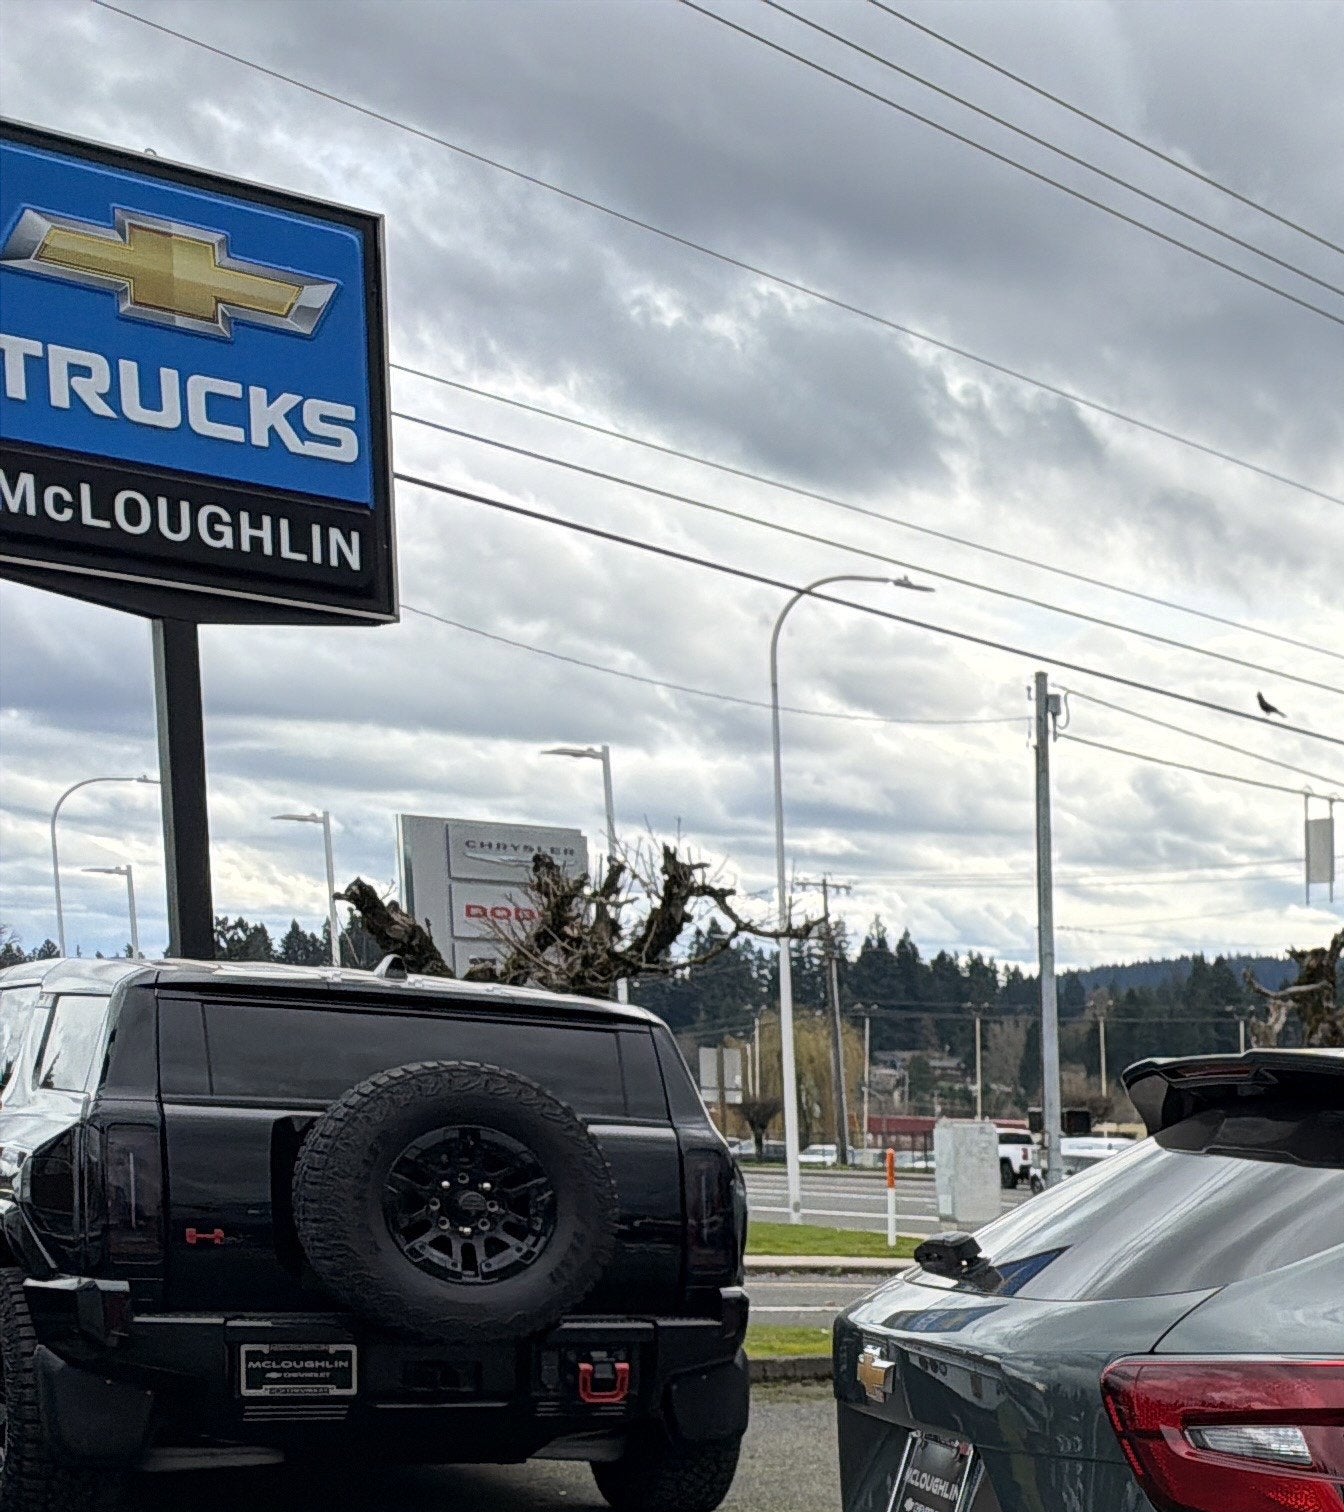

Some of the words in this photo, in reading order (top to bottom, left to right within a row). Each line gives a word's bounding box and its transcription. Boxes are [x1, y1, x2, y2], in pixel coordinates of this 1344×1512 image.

[0, 333, 359, 463] TRUCKS
[0, 468, 362, 571] McLOUGHLIN
[465, 839, 575, 857] CHRYSLER
[247, 1360, 349, 1369] MCLOUGHLIN
